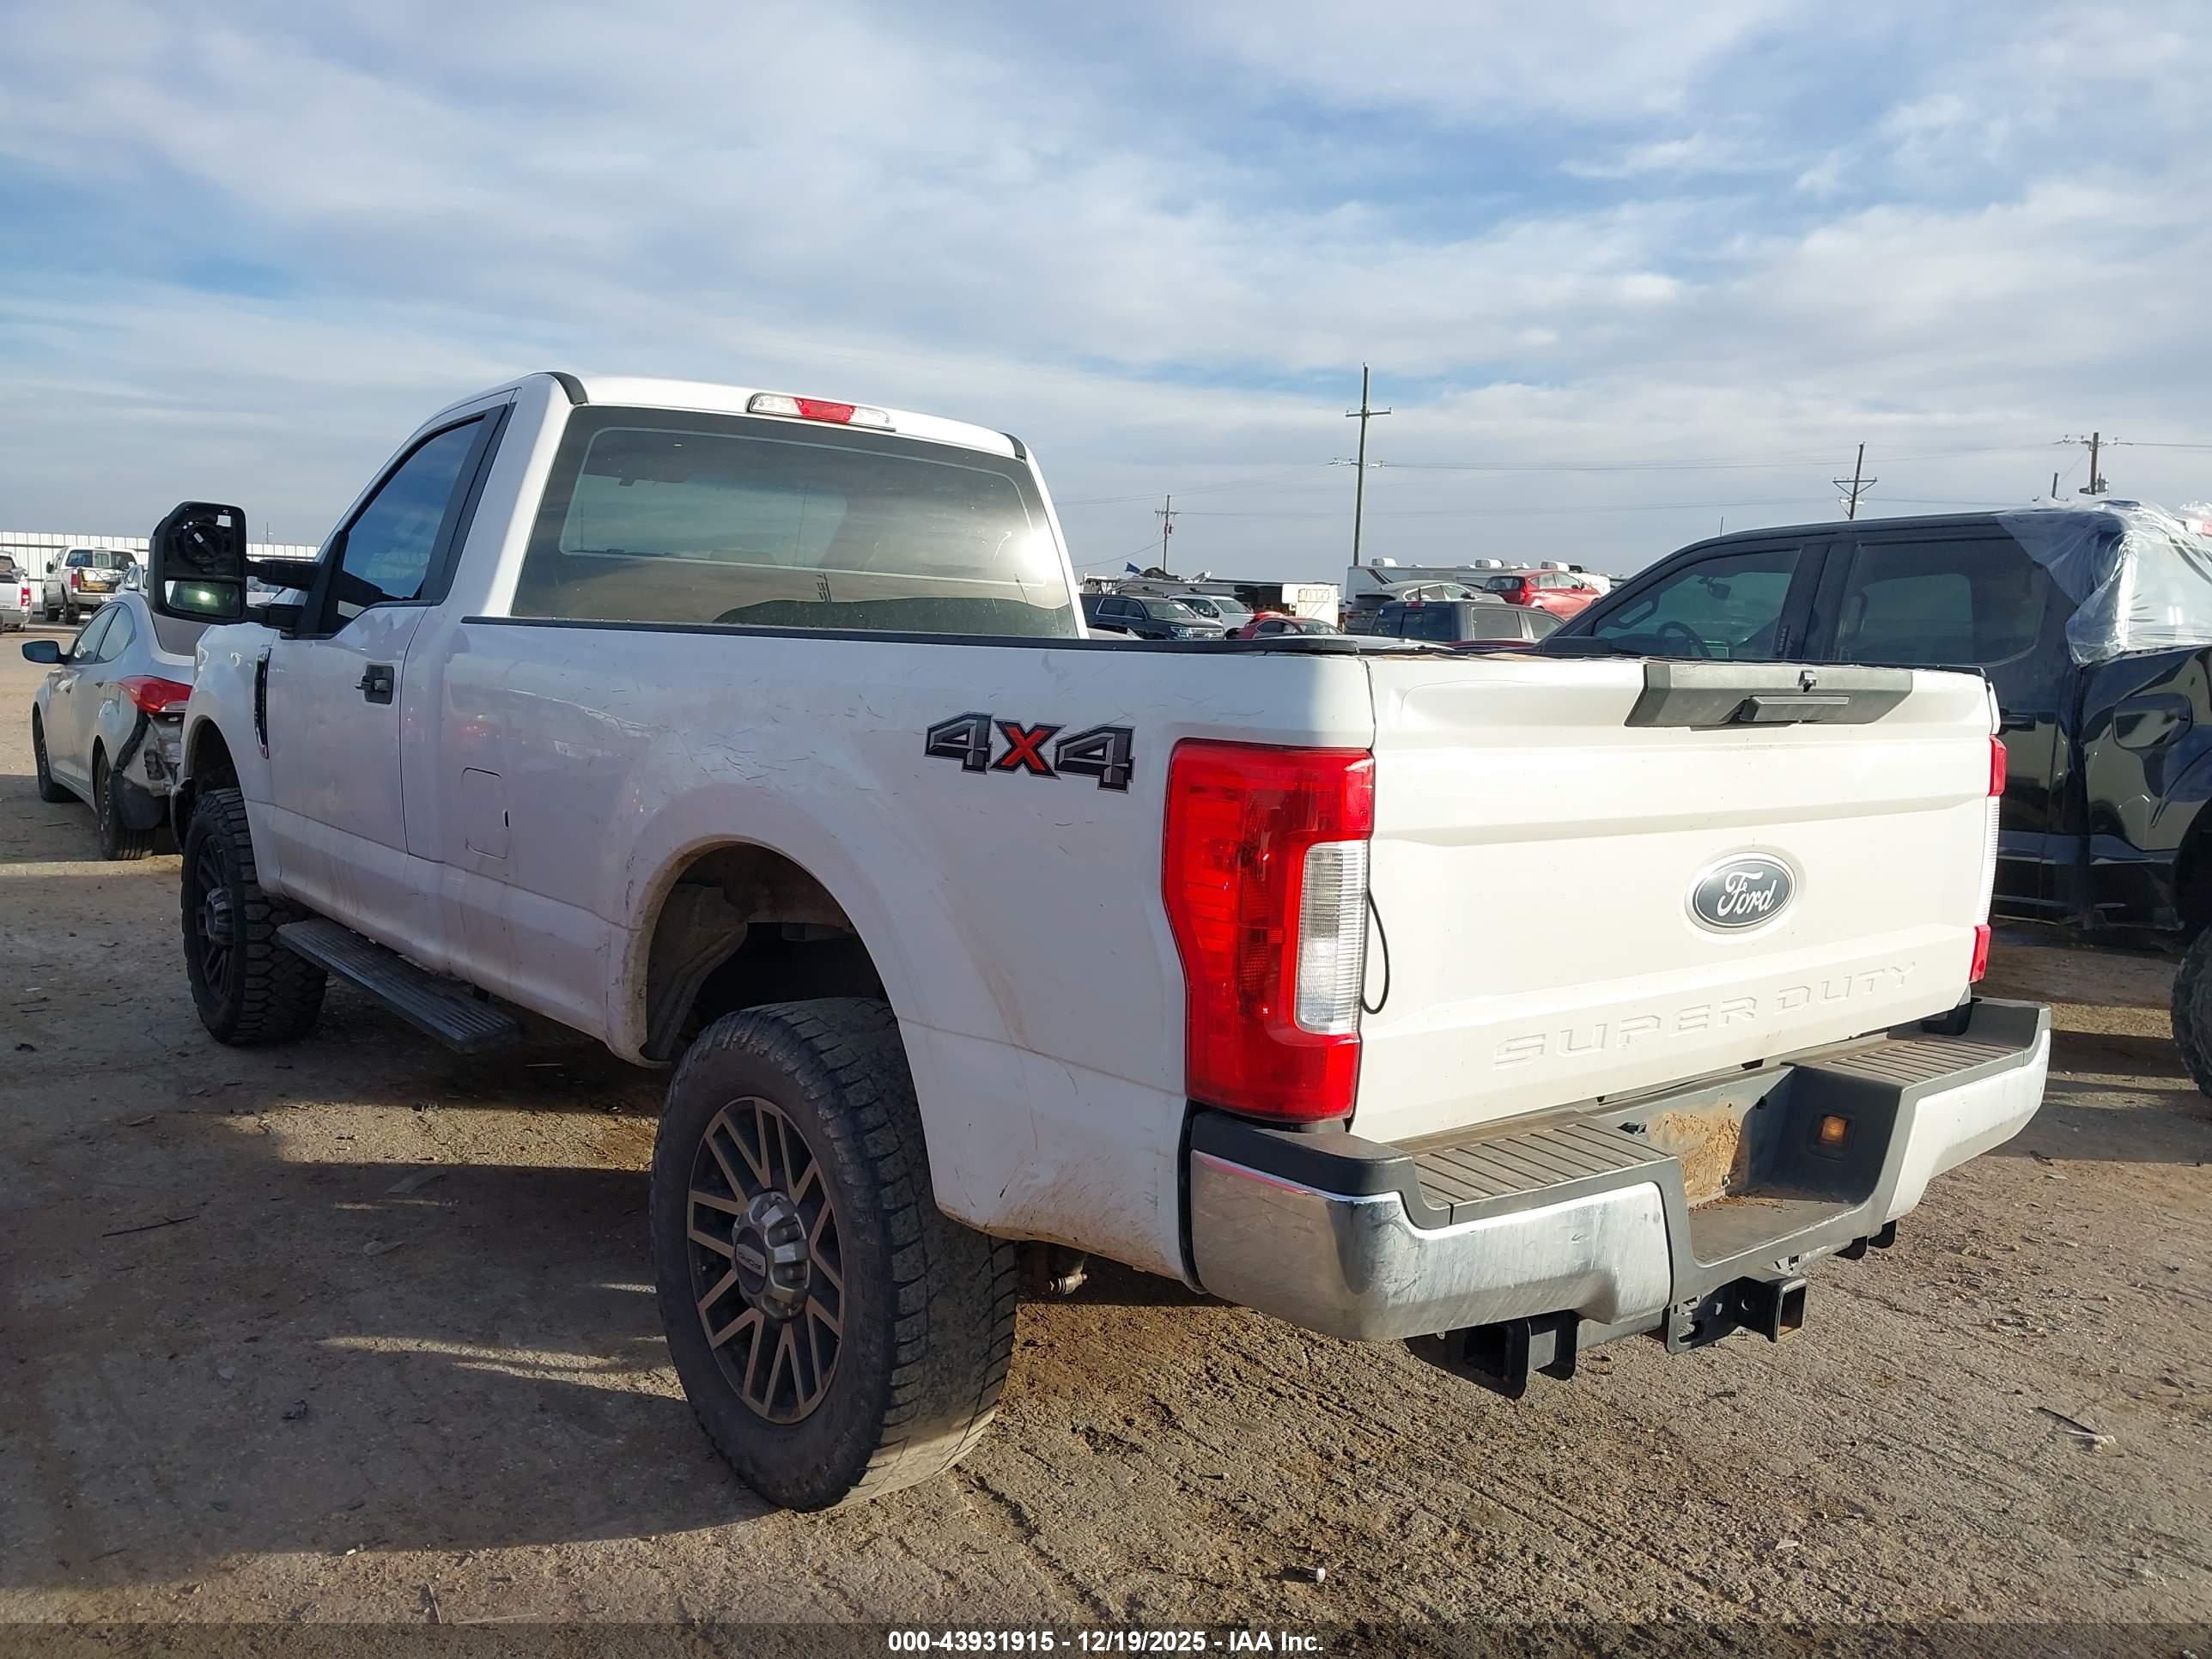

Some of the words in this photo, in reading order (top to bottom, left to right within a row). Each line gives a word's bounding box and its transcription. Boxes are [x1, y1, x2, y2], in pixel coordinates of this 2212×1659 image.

[1717, 871, 1778, 917] Ford
[1492, 995, 1758, 1071] SUPER
[1773, 961, 1916, 1017] DUTY
